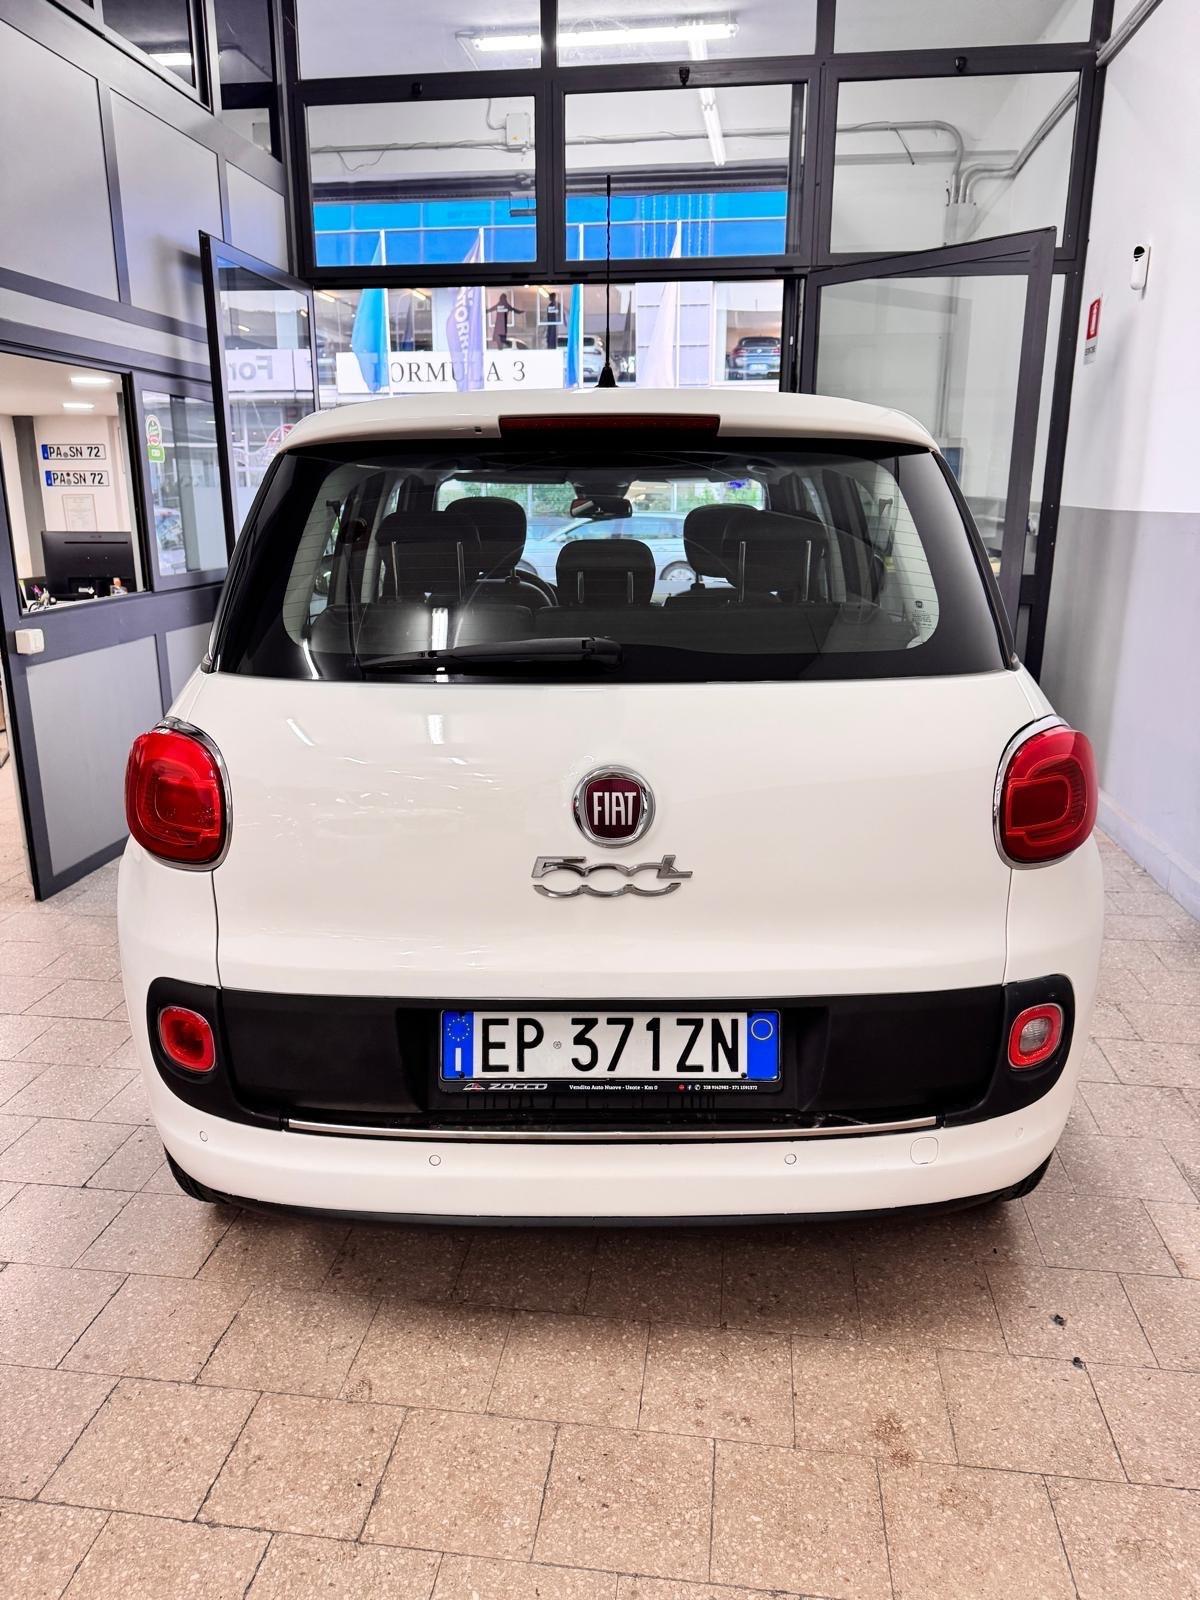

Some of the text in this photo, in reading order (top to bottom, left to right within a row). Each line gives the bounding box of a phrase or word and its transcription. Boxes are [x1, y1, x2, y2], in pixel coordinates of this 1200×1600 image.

[371, 360, 526, 383] ORMULA 3
[48, 446, 101, 459] PA SN 72
[52, 472, 104, 485] PA SN 72
[592, 791, 637, 826] FIAT
[531, 854, 693, 898] 500L
[481, 1017, 544, 1073] EP
[571, 1017, 739, 1073] 371ZN
[488, 1083, 548, 1091] ZOCCO
